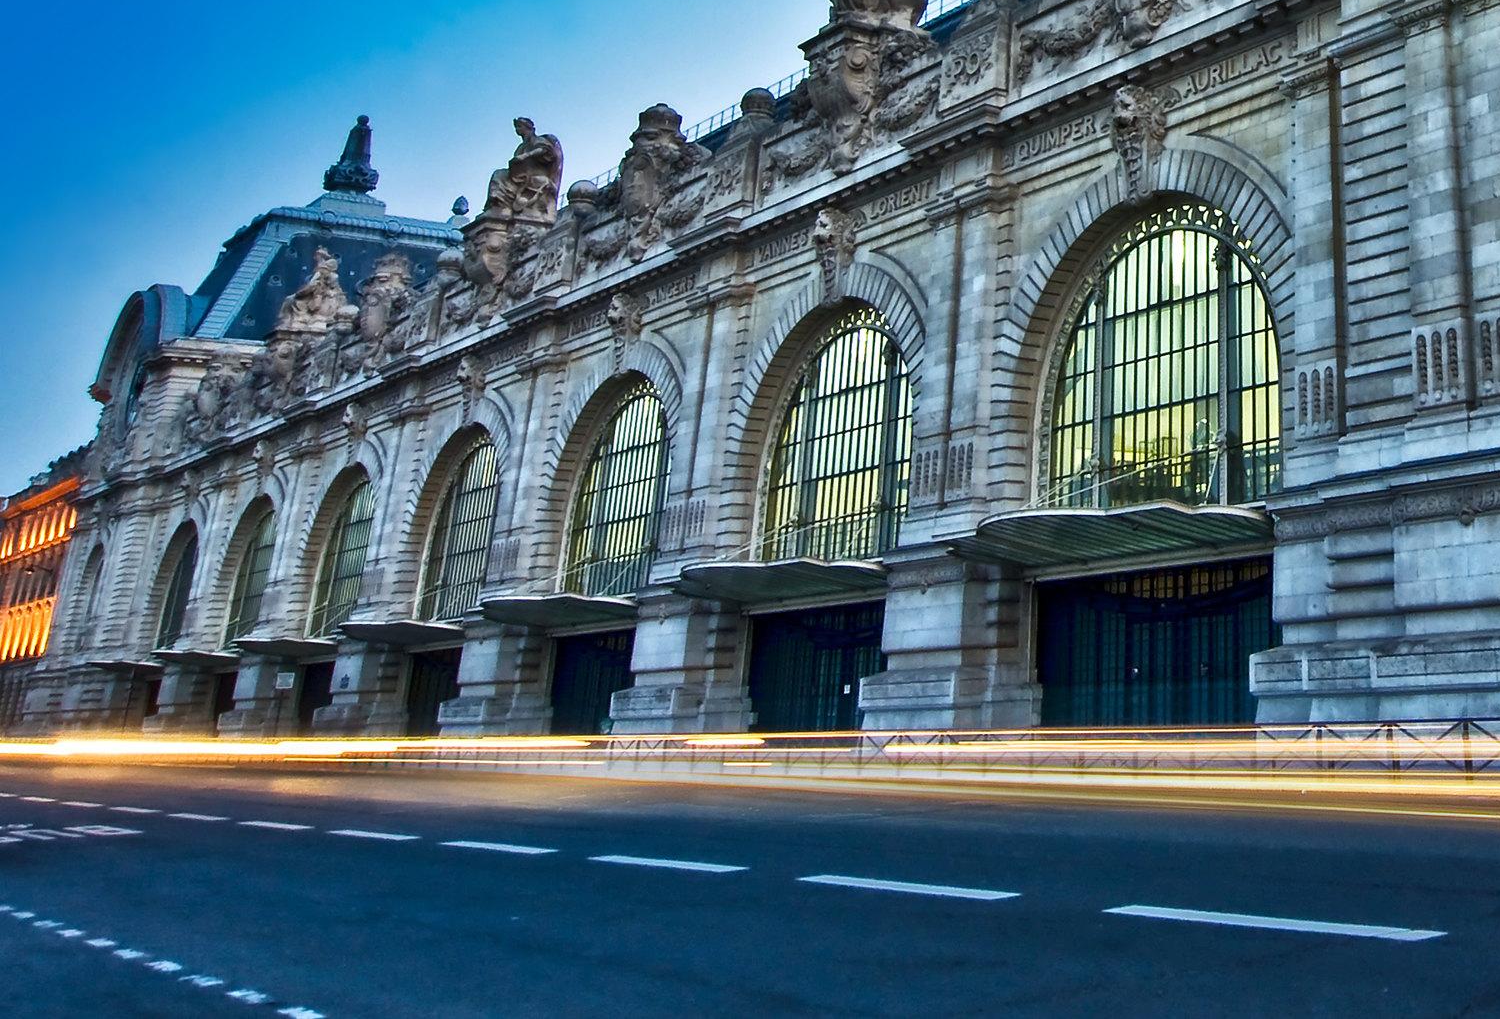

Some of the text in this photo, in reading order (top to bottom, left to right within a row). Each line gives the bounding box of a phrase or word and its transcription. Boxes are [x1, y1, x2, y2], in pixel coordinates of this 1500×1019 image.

[1183, 42, 1282, 98] AURILLAC
[1018, 114, 1096, 161] QUIMPER
[869, 179, 933, 220] LORIENT
[757, 231, 809, 264] VANNES
